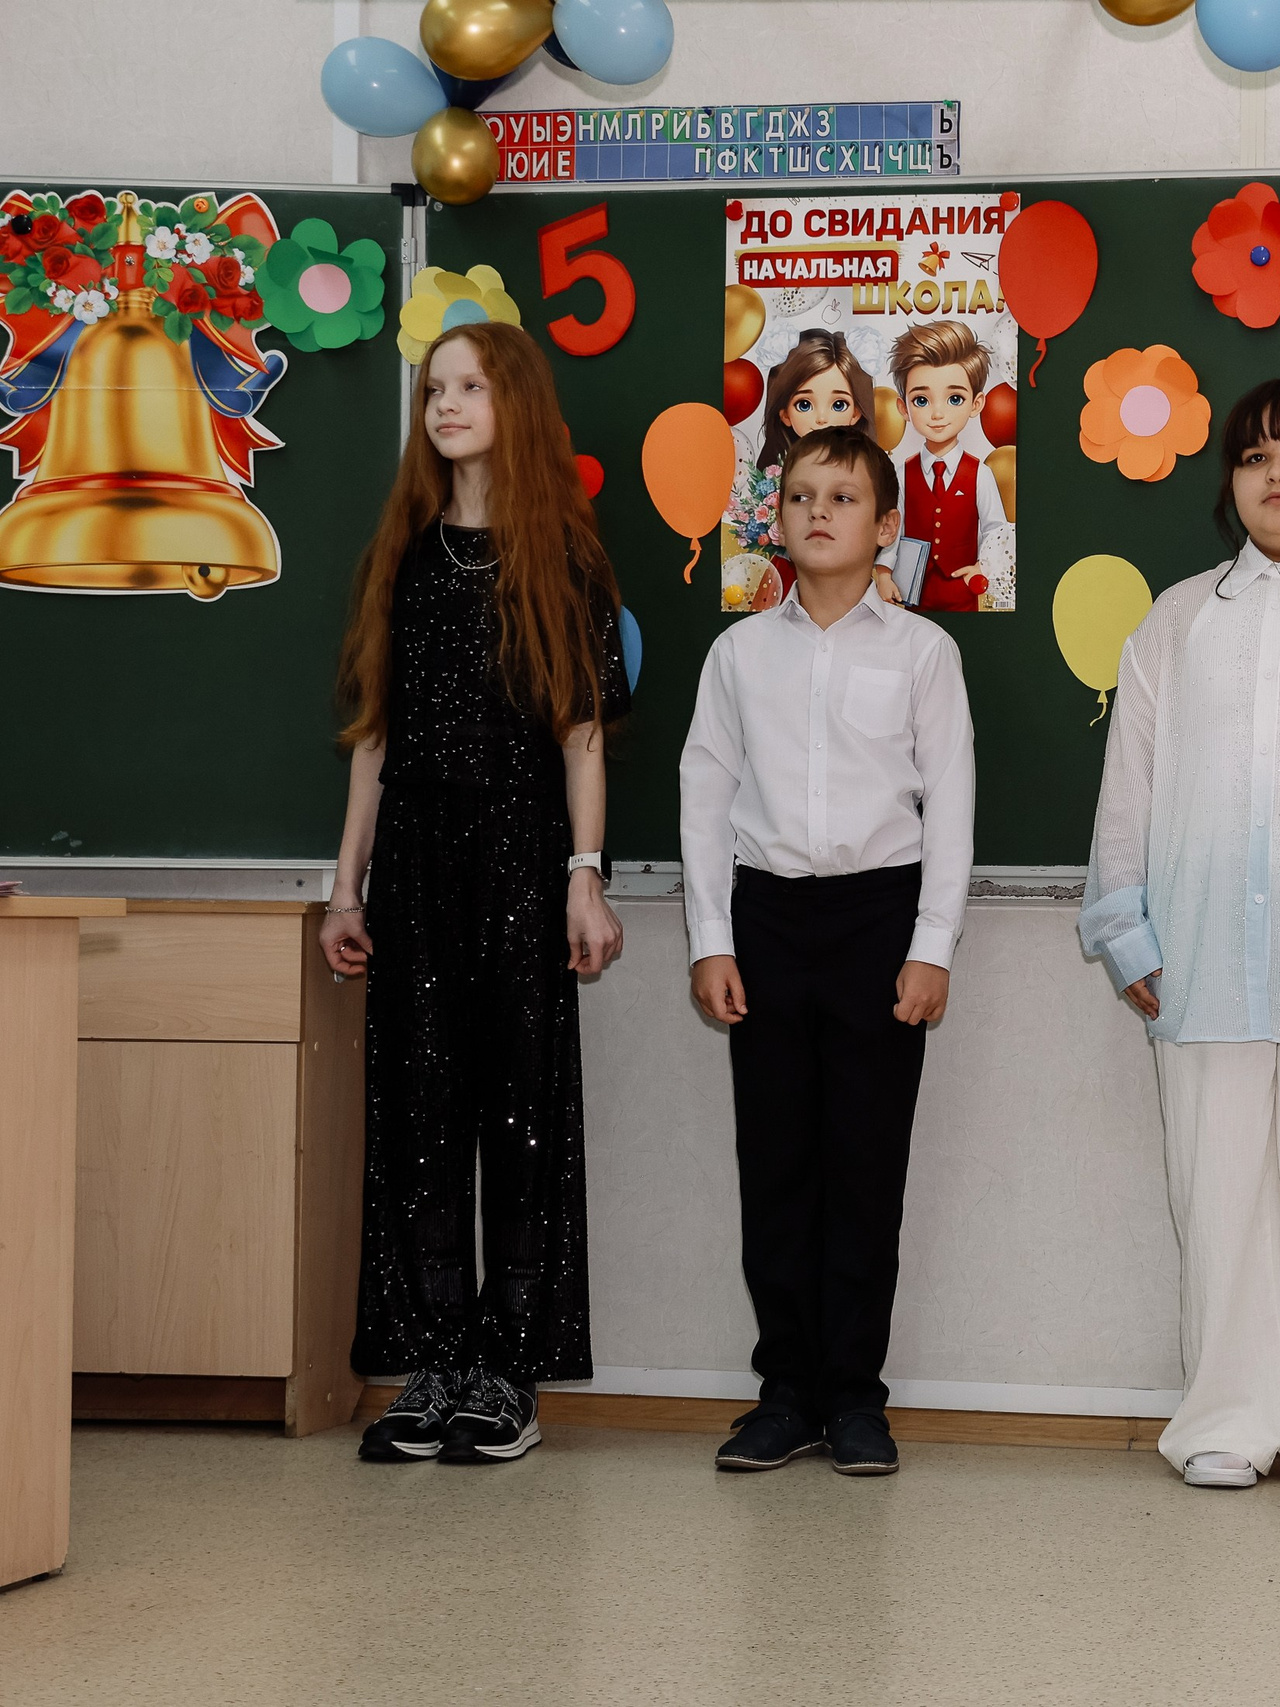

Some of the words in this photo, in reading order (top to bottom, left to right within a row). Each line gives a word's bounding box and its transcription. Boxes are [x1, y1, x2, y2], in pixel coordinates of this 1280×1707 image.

[740, 209, 793, 244] ДО
[804, 206, 1006, 242] СВИДАНИЯ
[537, 201, 636, 357] 5
[743, 256, 892, 281] НАЧАЛЬНАЯ
